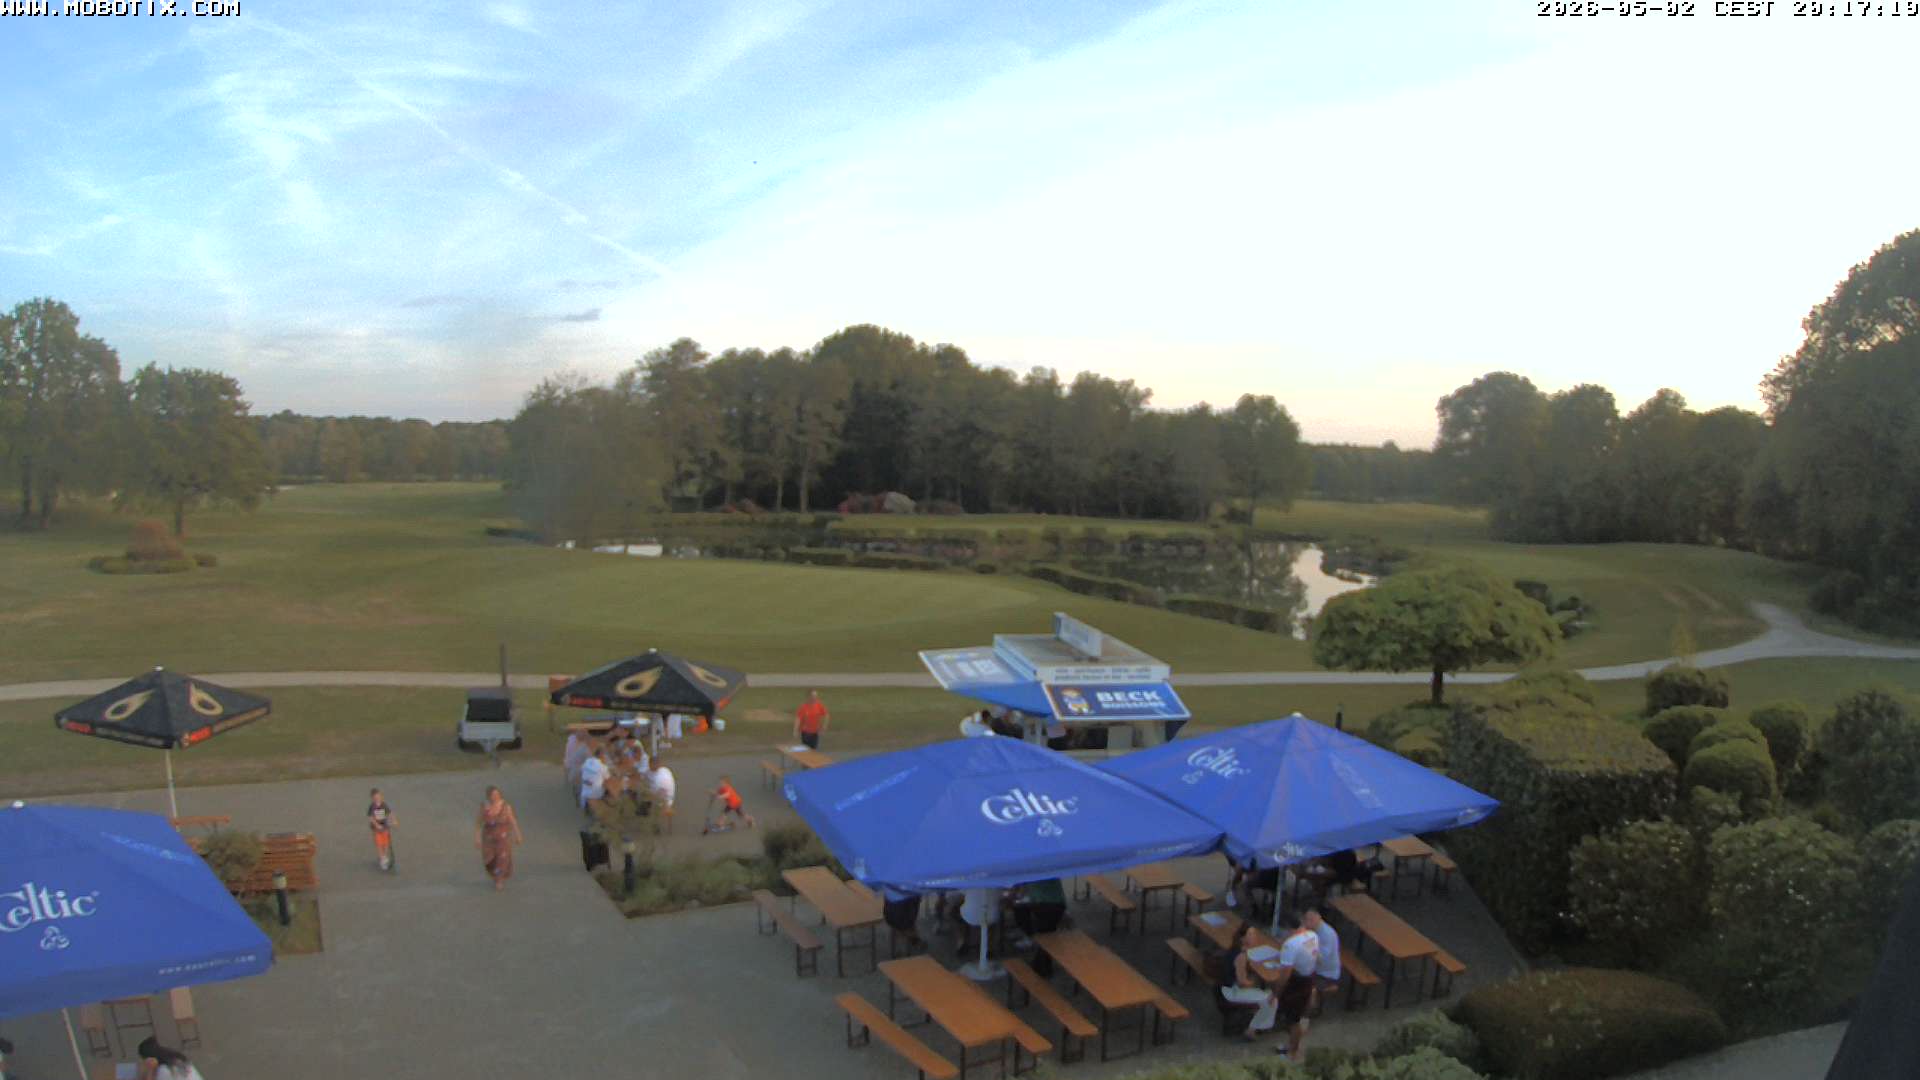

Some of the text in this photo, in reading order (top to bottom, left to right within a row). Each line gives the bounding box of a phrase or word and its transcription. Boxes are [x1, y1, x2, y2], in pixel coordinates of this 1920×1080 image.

[1096, 690, 1161, 702] BECK
[1187, 745, 1246, 780] Celtic
[981, 787, 1078, 825] Celtic
